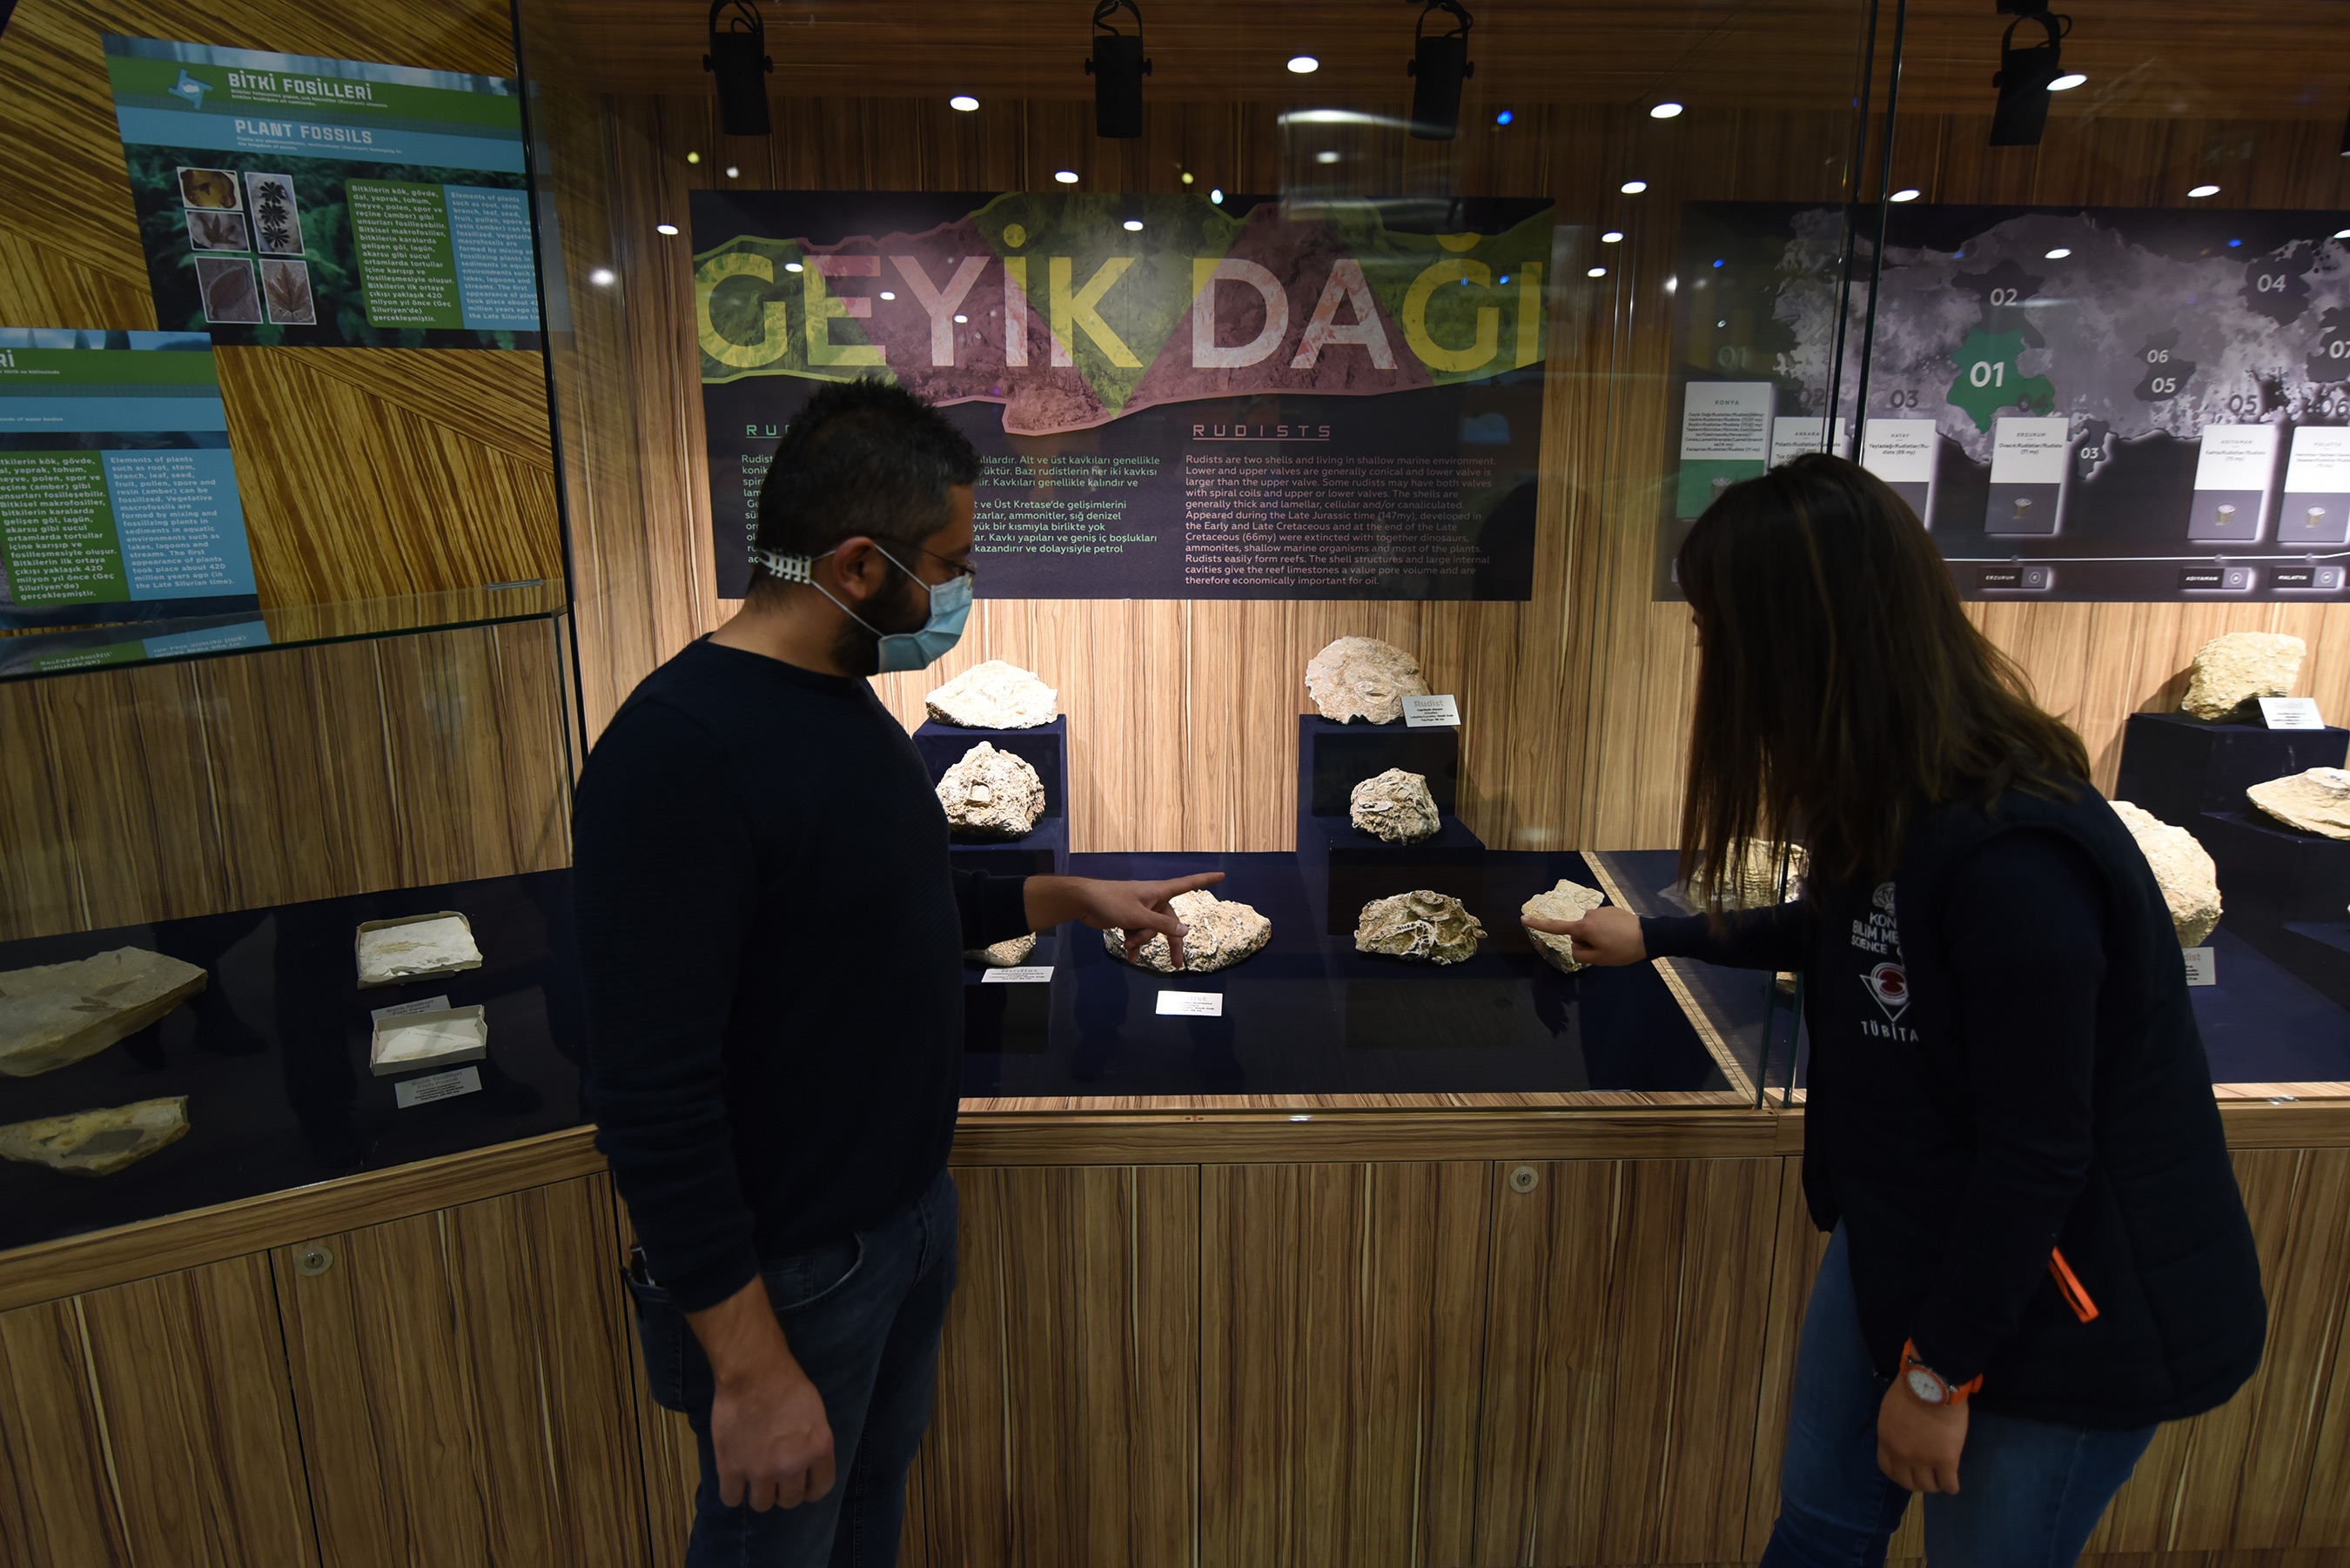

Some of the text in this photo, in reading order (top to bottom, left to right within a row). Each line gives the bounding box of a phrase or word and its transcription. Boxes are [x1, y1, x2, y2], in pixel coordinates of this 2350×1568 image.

[227, 70, 276, 91] BİTKİ
[283, 77, 373, 100] FOSİLLERİ
[234, 119, 373, 144] PLANT FOSSILS
[352, 184, 389, 193] Bitkilerin
[392, 187, 409, 196] kök,
[450, 191, 485, 200] Elements
[402, 197, 431, 205] tohum,
[394, 219, 446, 229] fosilleşebilir.
[2258, 274, 2286, 292] 04
[696, 223, 1543, 370] GEYİK DAĞI
[1991, 288, 2018, 306] 02
[1717, 345, 1747, 368] 01
[2147, 349, 2168, 364] 06
[1970, 361, 2004, 386] 01
[2152, 377, 2175, 393] 05
[1797, 388, 1825, 405] 02
[1890, 390, 1918, 408] 03
[2017, 392, 2049, 412] 04
[2229, 394, 2258, 415] 05
[2320, 397, 2350, 416] 06
[1193, 425, 1331, 437] RUDISTS
[742, 454, 773, 463] Rudist
[2081, 447, 2098, 459] 03
[1019, 455, 1033, 464] Alt
[1051, 455, 1065, 464] üst
[1069, 456, 1110, 467] kavkıları
[1112, 456, 1159, 466] genellikle
[1185, 454, 1222, 464] Rudists
[1265, 455, 1292, 464] shells
[1295, 455, 1313, 464] and
[1316, 455, 1343, 466] living
[1346, 455, 1354, 464] in
[1357, 456, 1394, 465] shallow
[1397, 456, 1430, 465] marine
[1433, 456, 1496, 465] environment.
[1015, 466, 1035, 475] Bazı
[1038, 466, 1089, 475] rudistlerin
[1091, 466, 1106, 475] her
[1110, 466, 1120, 475] iki
[1124, 467, 1157, 476] kavkısı
[992, 478, 1035, 486] Kavkıları
[1037, 478, 1084, 488] genellikle
[1087, 478, 1124, 486] kalındır
[994, 499, 1010, 508] Üst
[1013, 499, 1064, 509] Kretase’de
[1067, 499, 1126, 511] gelişimlerini
[1008, 511, 1067, 520] ammonitler,
[1069, 511, 1083, 521] sığ
[1086, 511, 1121, 519] denizel
[1185, 510, 1232, 520] Appeared
[1235, 510, 1266, 521] during
[1288, 511, 1309, 519] Late
[1313, 511, 1350, 519] Jurassic
[1353, 511, 1374, 519] time
[1377, 511, 1417, 522] (147my),
[1420, 512, 1470, 521] developed
[992, 522, 1005, 531] bir
[1008, 522, 1048, 533] kısmıyla
[1051, 522, 1085, 531] birlikte
[1088, 522, 1104, 533] yok
[975, 544, 1022, 553] kazandırır
[1039, 544, 1091, 554] dolayısiyle
[1093, 544, 1123, 554] petrol
[1185, 565, 1221, 573] cavities
[1224, 565, 1244, 575] give
[1247, 565, 1262, 573] the
[1266, 565, 1284, 573] reef
[1286, 565, 1339, 573] limestones
[1378, 567, 1400, 576] pore
[1440, 566, 1458, 574] and
[1185, 575, 1230, 584] therefore
[1232, 576, 1295, 586] economically
[1298, 576, 1346, 586] important
[1365, 576, 1379, 585] oil.
[1870, 912, 1897, 928] KON
[1881, 929, 1899, 944] ME
[1850, 935, 1888, 955] SCIENCE
[2184, 953, 2201, 962] dist
[1860, 1020, 1918, 1042] TÜBİTA
